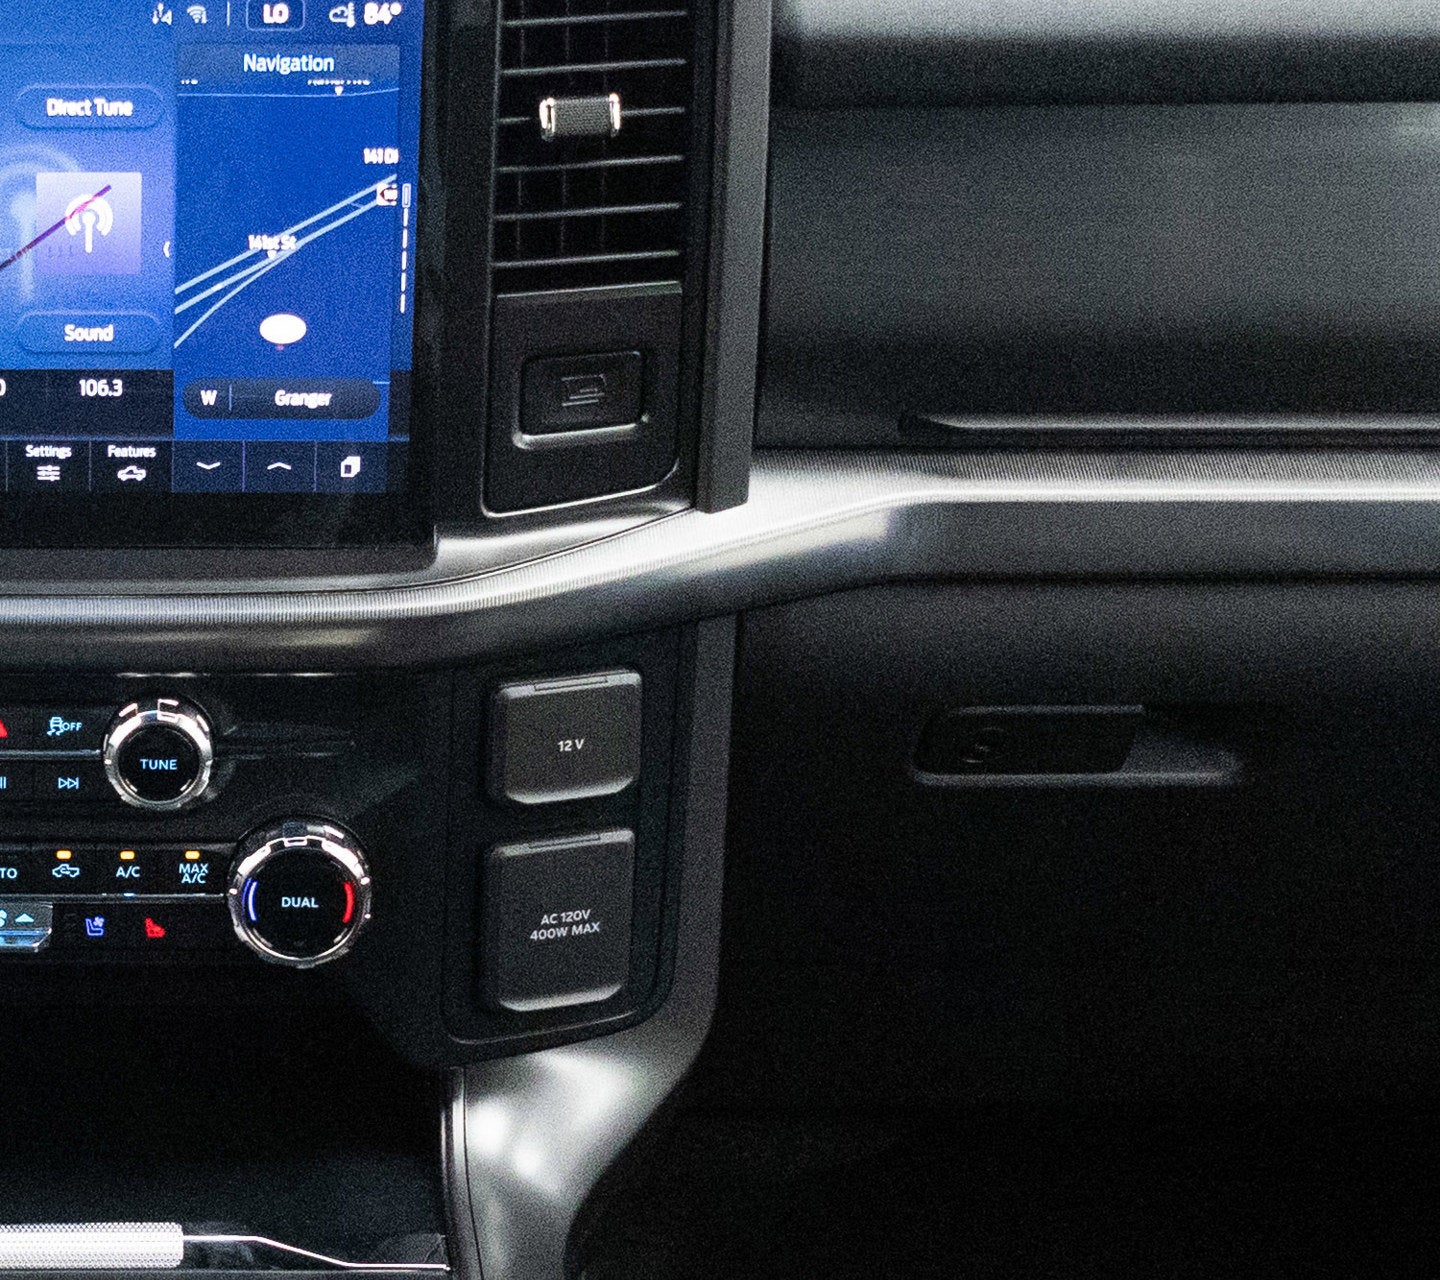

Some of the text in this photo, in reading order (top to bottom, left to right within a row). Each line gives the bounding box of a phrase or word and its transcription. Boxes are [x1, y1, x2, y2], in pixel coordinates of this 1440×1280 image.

[263, 3, 290, 24] LO
[243, 53, 335, 75] Navigation
[46, 98, 133, 117] Direct Tune
[64, 324, 115, 343] Sound
[79, 378, 124, 398] 106.3
[200, 389, 334, 409] W Granger
[25, 444, 73, 461] Settings
[107, 444, 157, 459] Features
[62, 721, 82, 733] OFF
[557, 738, 585, 752] 12 V
[140, 758, 178, 771] TUNE
[115, 865, 141, 879] A/C
[179, 863, 209, 874] MAX
[181, 873, 207, 885] A/C
[281, 896, 319, 909] DUAL
[541, 909, 591, 925] AC 120V
[530, 921, 600, 942] 400W MAX
